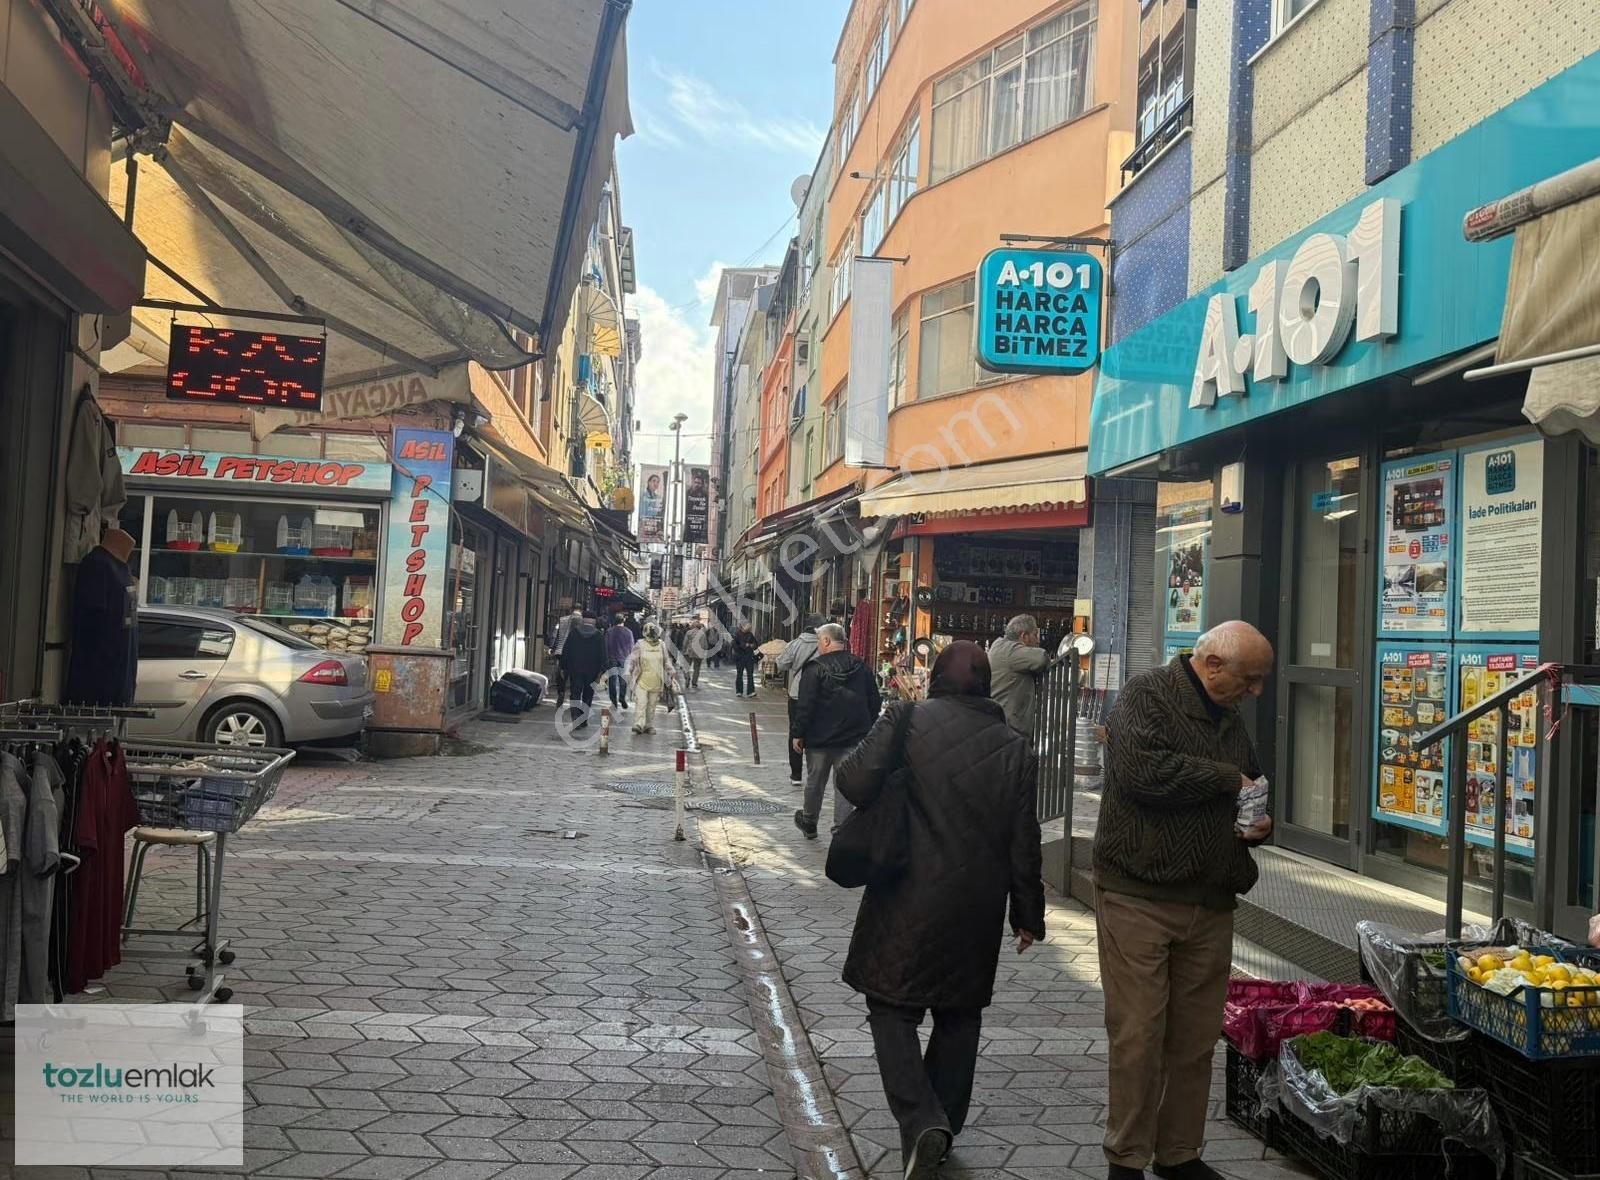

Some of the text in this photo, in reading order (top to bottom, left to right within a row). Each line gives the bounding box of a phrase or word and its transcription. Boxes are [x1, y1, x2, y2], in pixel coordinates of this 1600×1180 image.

[996, 290, 1089, 314] HARCA
[995, 313, 1088, 337] HARCA
[213, 456, 366, 487] PETSHOP
[1488, 499, 1537, 517] Politikaları
[400, 474, 433, 646] PETSHOP
